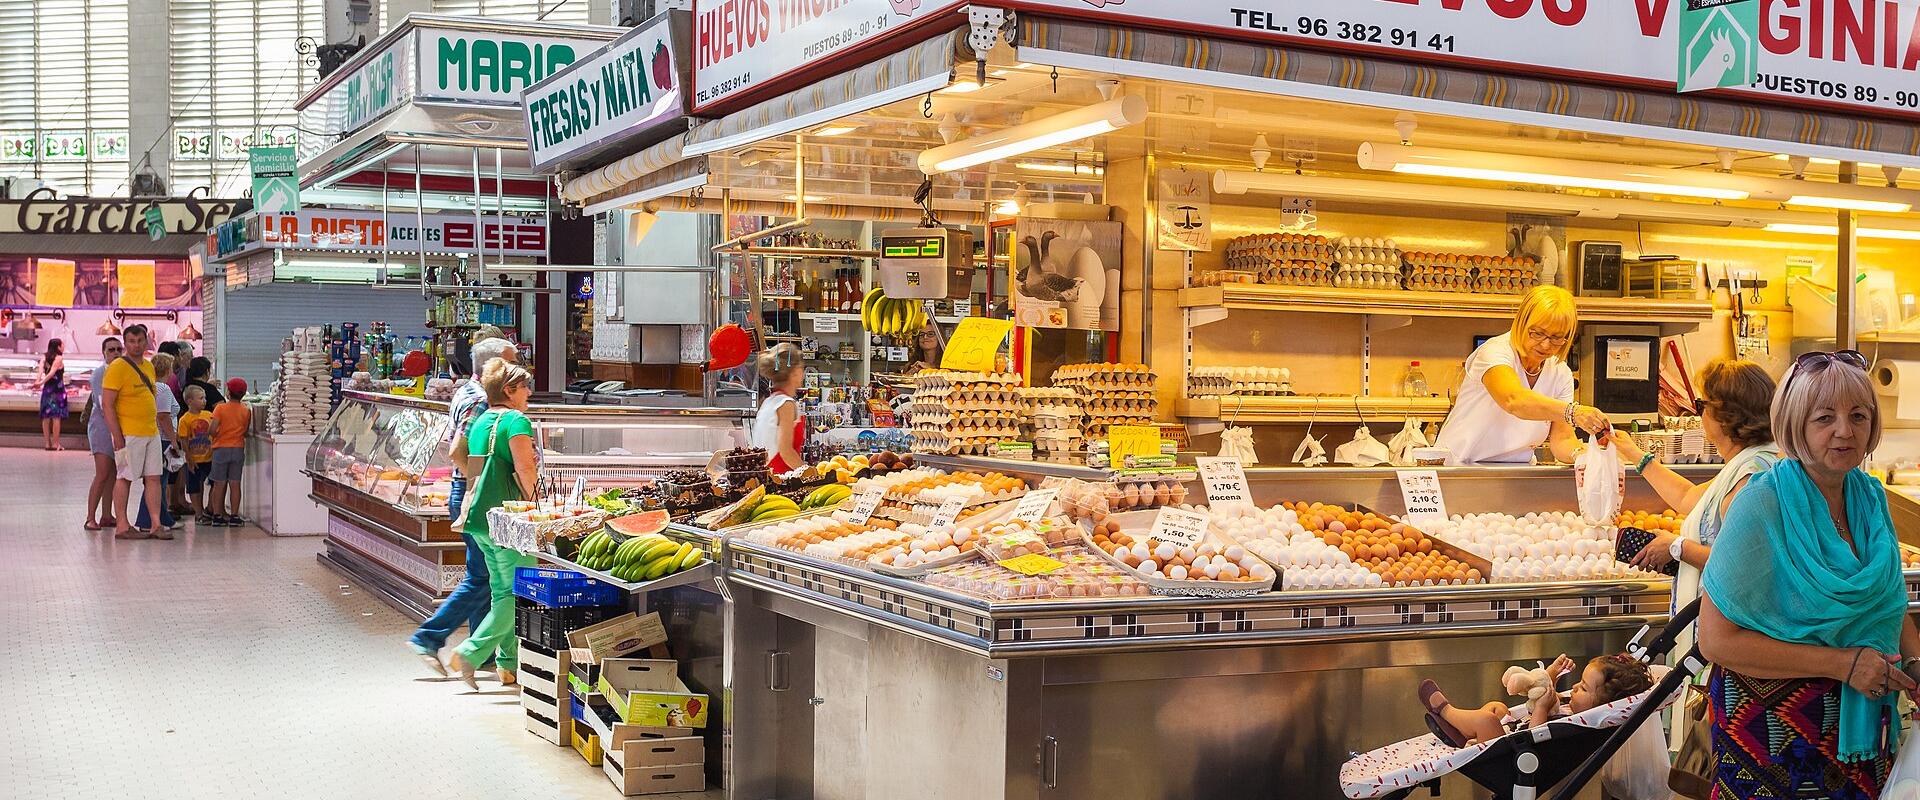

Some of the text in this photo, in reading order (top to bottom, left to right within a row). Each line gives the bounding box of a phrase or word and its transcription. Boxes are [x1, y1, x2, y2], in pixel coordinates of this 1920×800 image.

[700, 0, 769, 70] HUEVOS
[803, 33, 840, 60] PUESTOS
[842, 28, 853, 43] 89
[859, 21, 870, 36] 90
[877, 14, 887, 29] 91
[1231, 9, 1455, 53] TEL. 96 382 91 41
[370, 52, 393, 114] ROSA
[530, 78, 591, 152] FRESAS
[601, 47, 651, 121] NATA
[697, 71, 751, 104] TEL. 96 382 91 41
[1751, 73, 1847, 99] PUESTOS
[1854, 86, 1877, 103] 89
[1896, 91, 1918, 108] 90
[252, 152, 288, 163] Servicio
[255, 162, 295, 172] domicilio
[265, 215, 299, 244] LA
[1411, 495, 1429, 503] 2,10
[1162, 528, 1185, 538] 1,50
